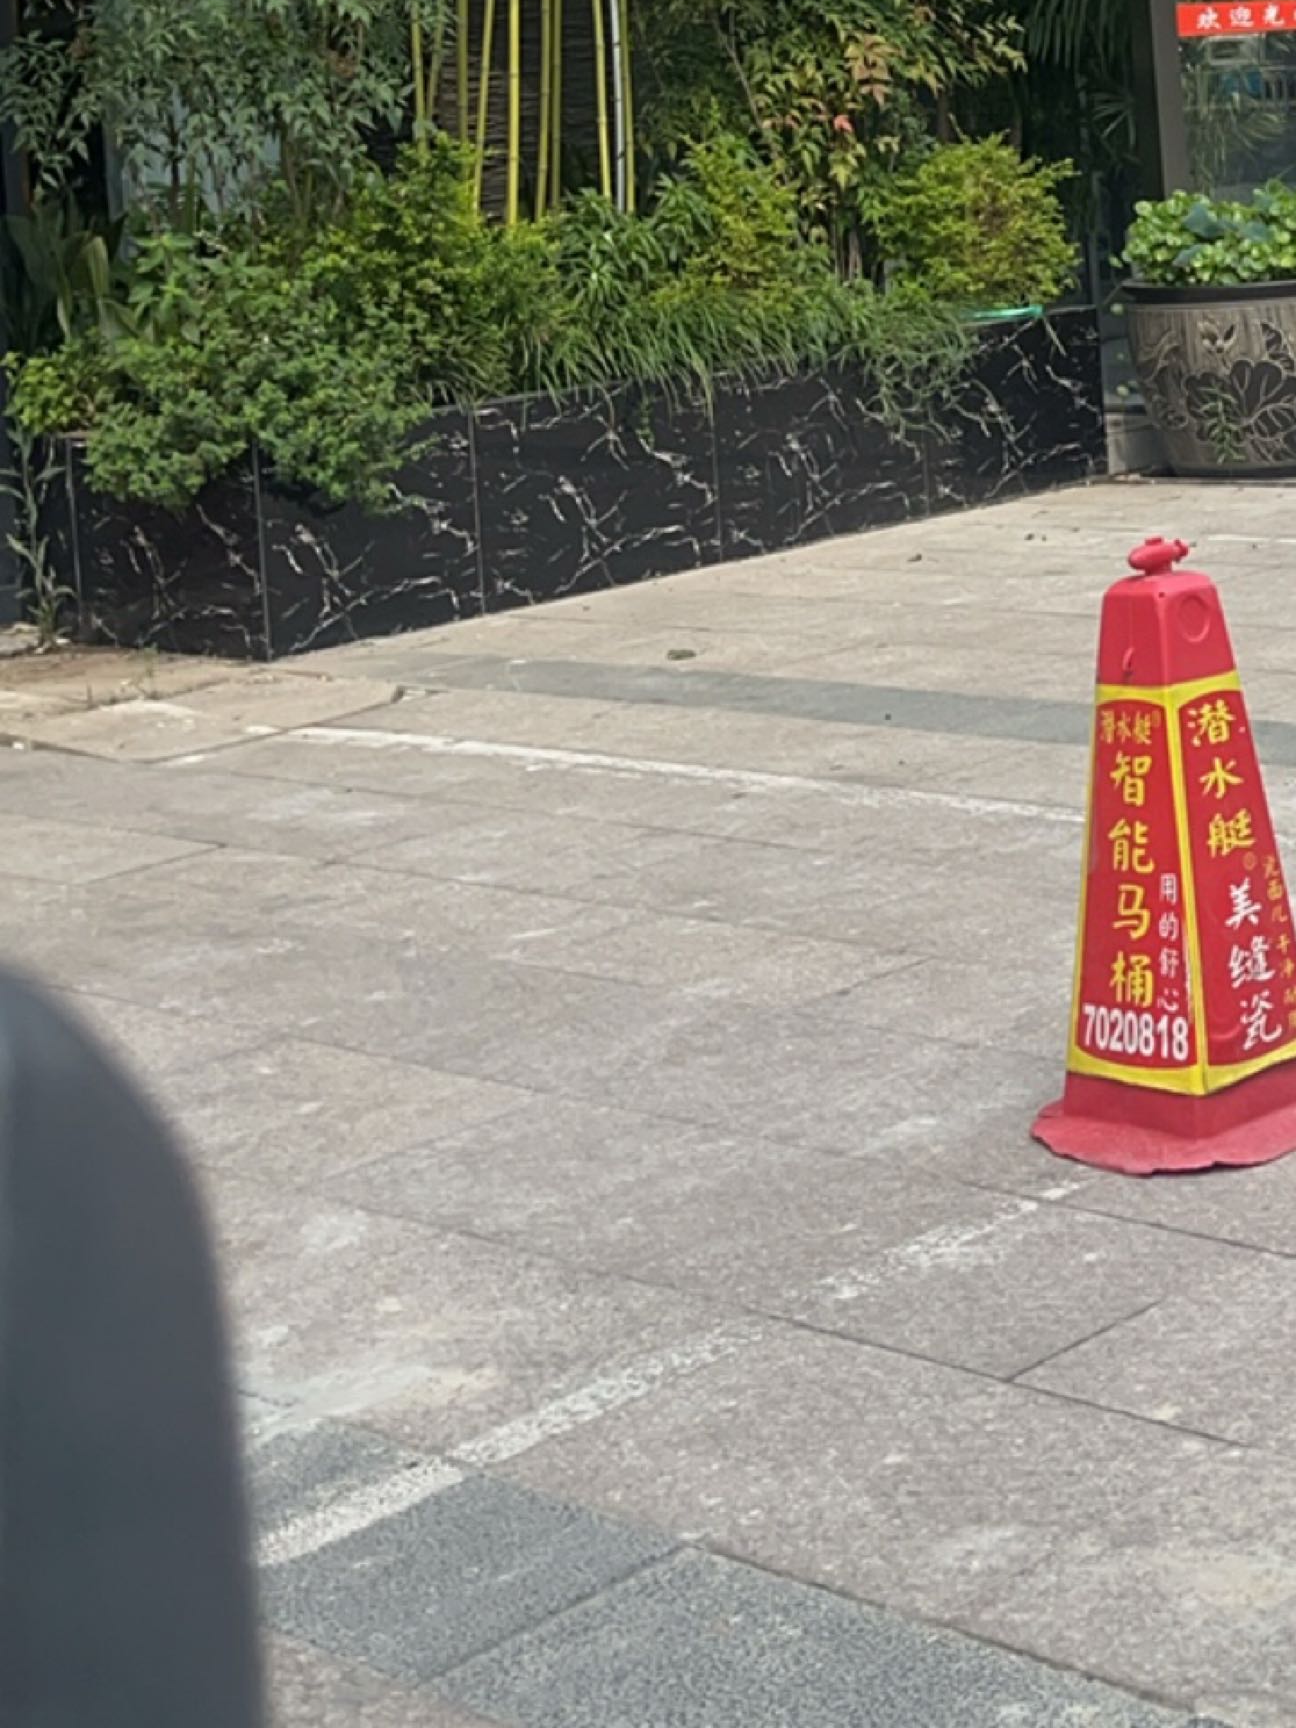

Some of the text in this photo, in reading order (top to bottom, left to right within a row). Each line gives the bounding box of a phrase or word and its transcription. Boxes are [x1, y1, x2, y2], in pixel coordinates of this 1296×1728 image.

[1187, 698, 1256, 858] 潜水艇
[1108, 752, 1155, 1009] 智能马桶
[1224, 877, 1282, 1051] 美缝瓷
[1082, 1002, 1189, 1061] 7020818
